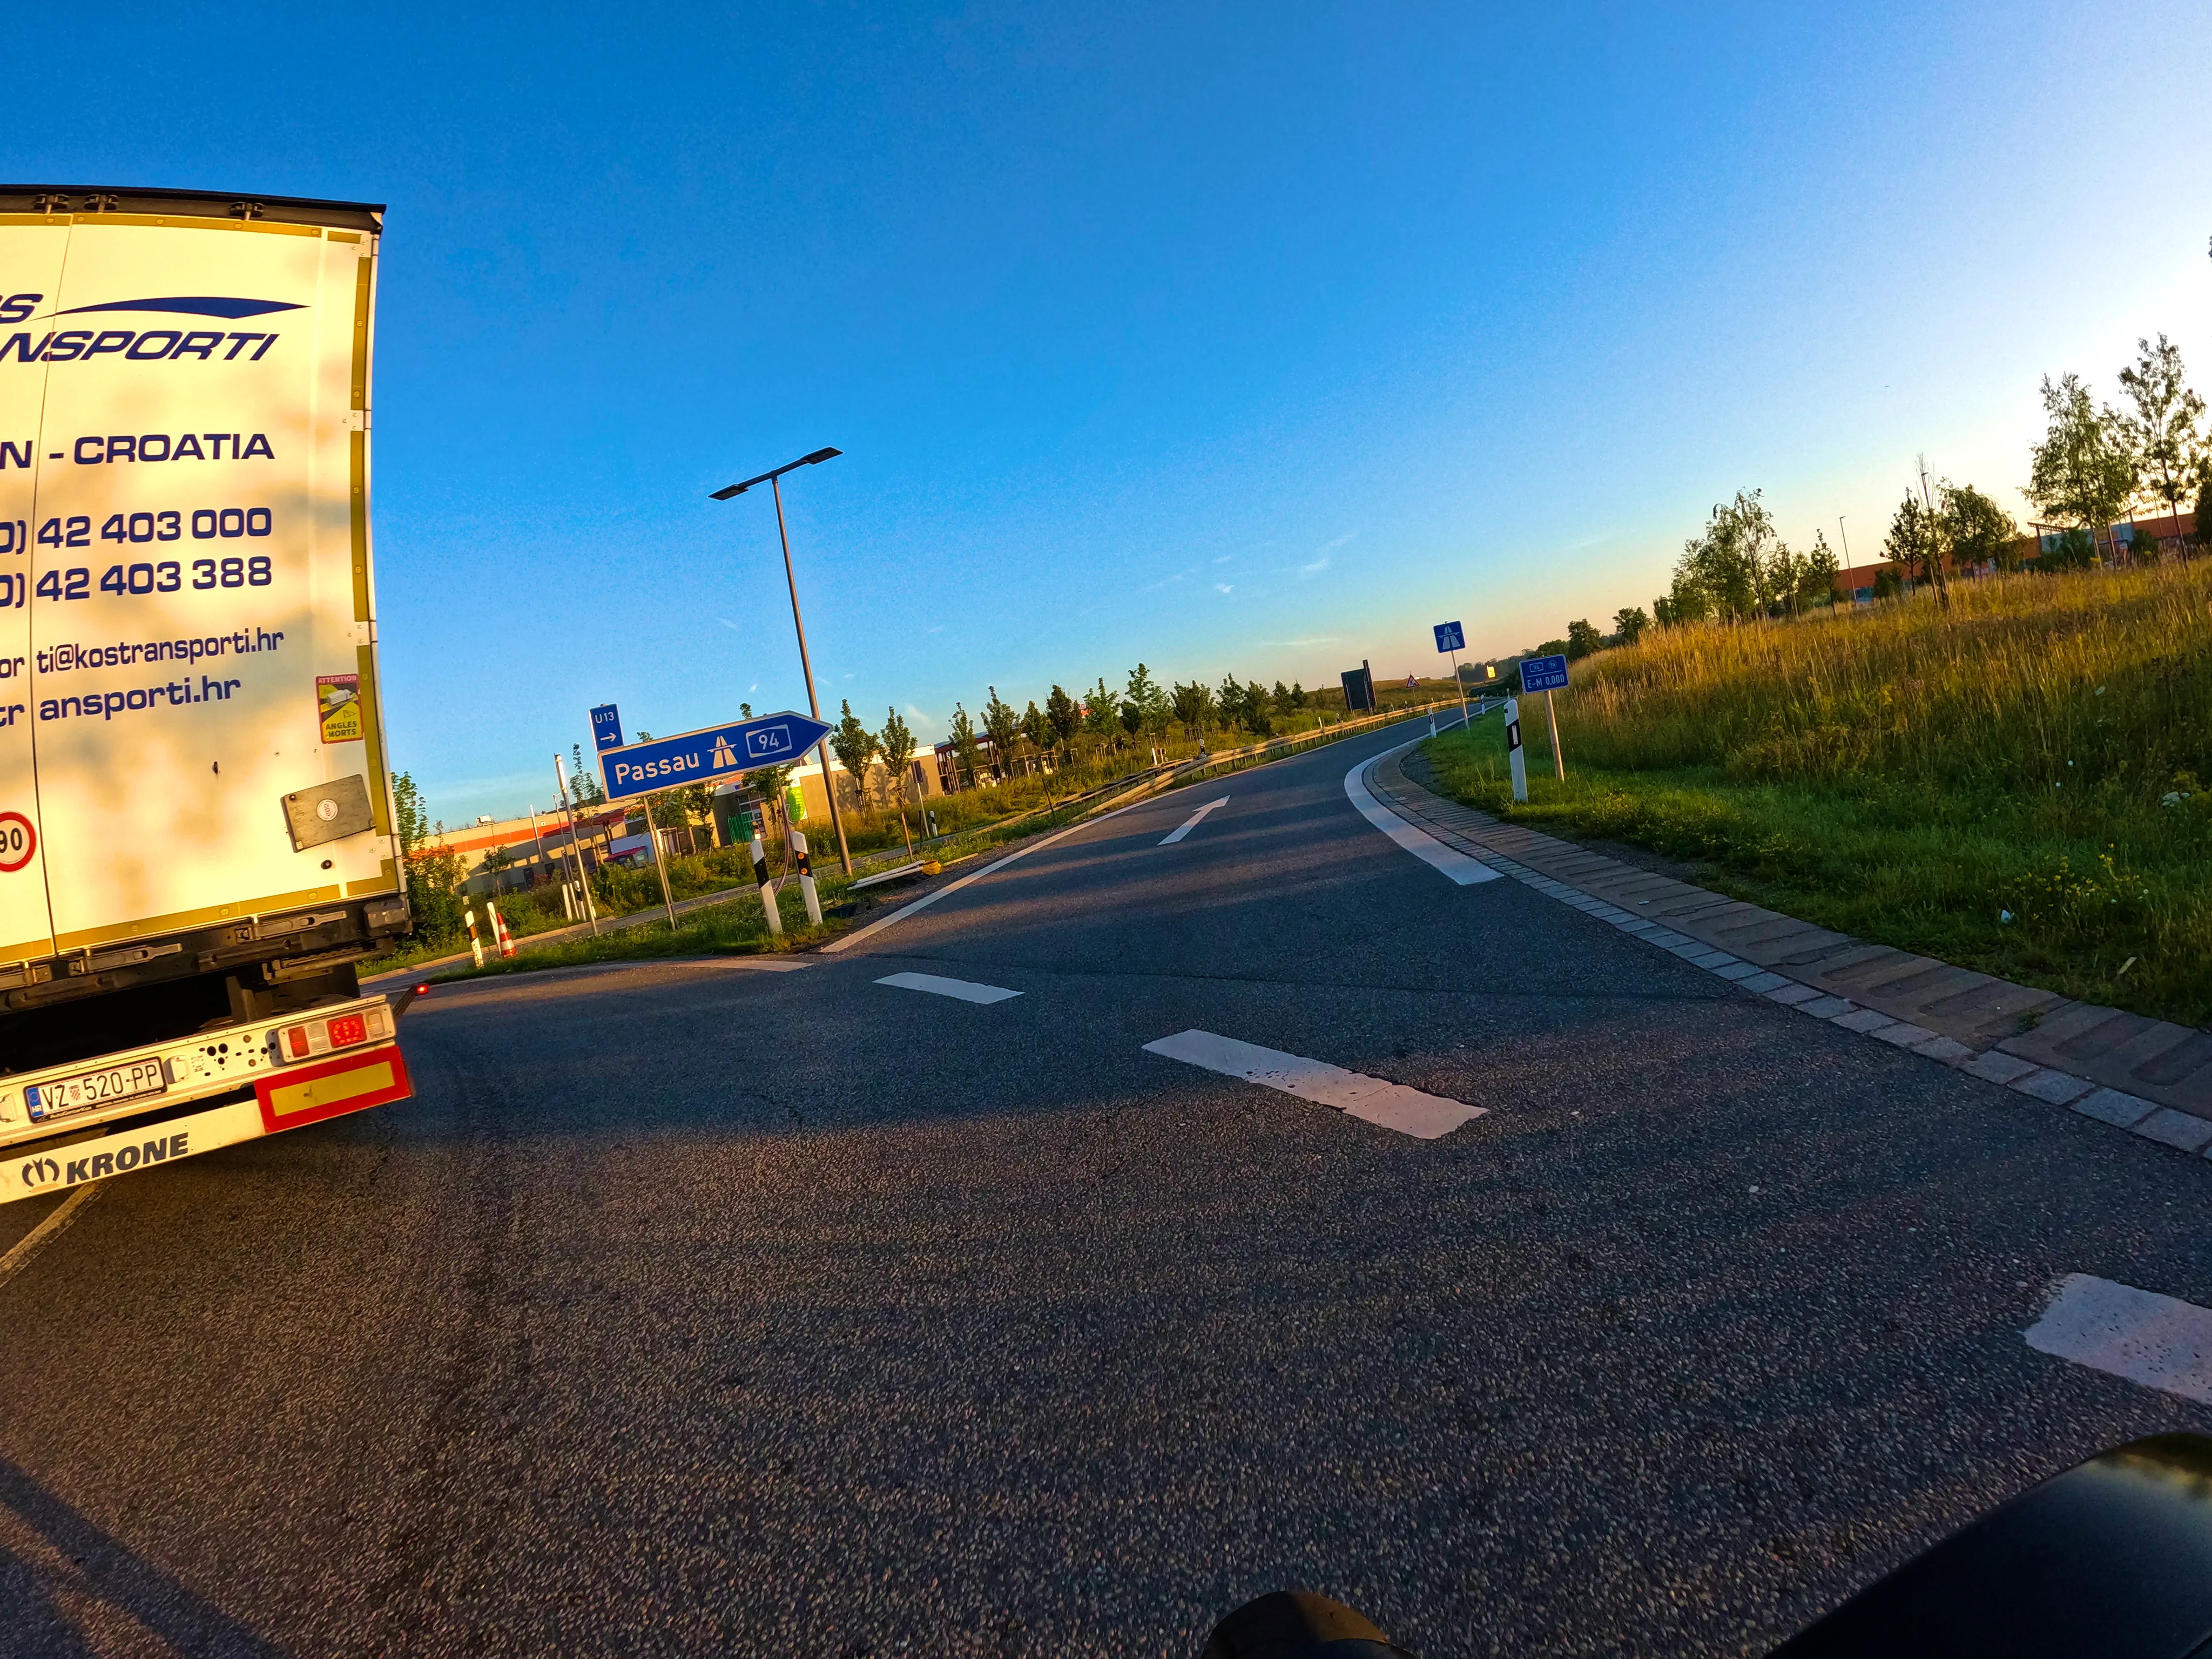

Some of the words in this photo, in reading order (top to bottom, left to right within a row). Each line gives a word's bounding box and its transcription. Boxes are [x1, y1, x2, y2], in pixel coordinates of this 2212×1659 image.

[0, 293, 44, 323] S
[0, 440, 33, 469] N
[75, 434, 275, 464] CROATIA
[37, 516, 90, 549] 42
[101, 511, 181, 543] 403
[192, 508, 272, 538] 000
[36, 568, 90, 602] 42
[100, 562, 181, 596] 403
[192, 557, 272, 589] 388
[36, 628, 284, 673] ti@kostransporti.hr
[318, 675, 357, 683] ATTENTION
[40, 675, 241, 720] ansporti.hr
[326, 721, 357, 730] ANGLES
[328, 728, 356, 737] MORTS
[595, 712, 614, 724] U13
[615, 752, 699, 785] Passau
[758, 732, 779, 750] 94
[0, 828, 23, 853] 90
[83, 1064, 158, 1101] 520-PP
[31, 1104, 43, 1113] HR
[66, 1132, 189, 1184] KRONE
